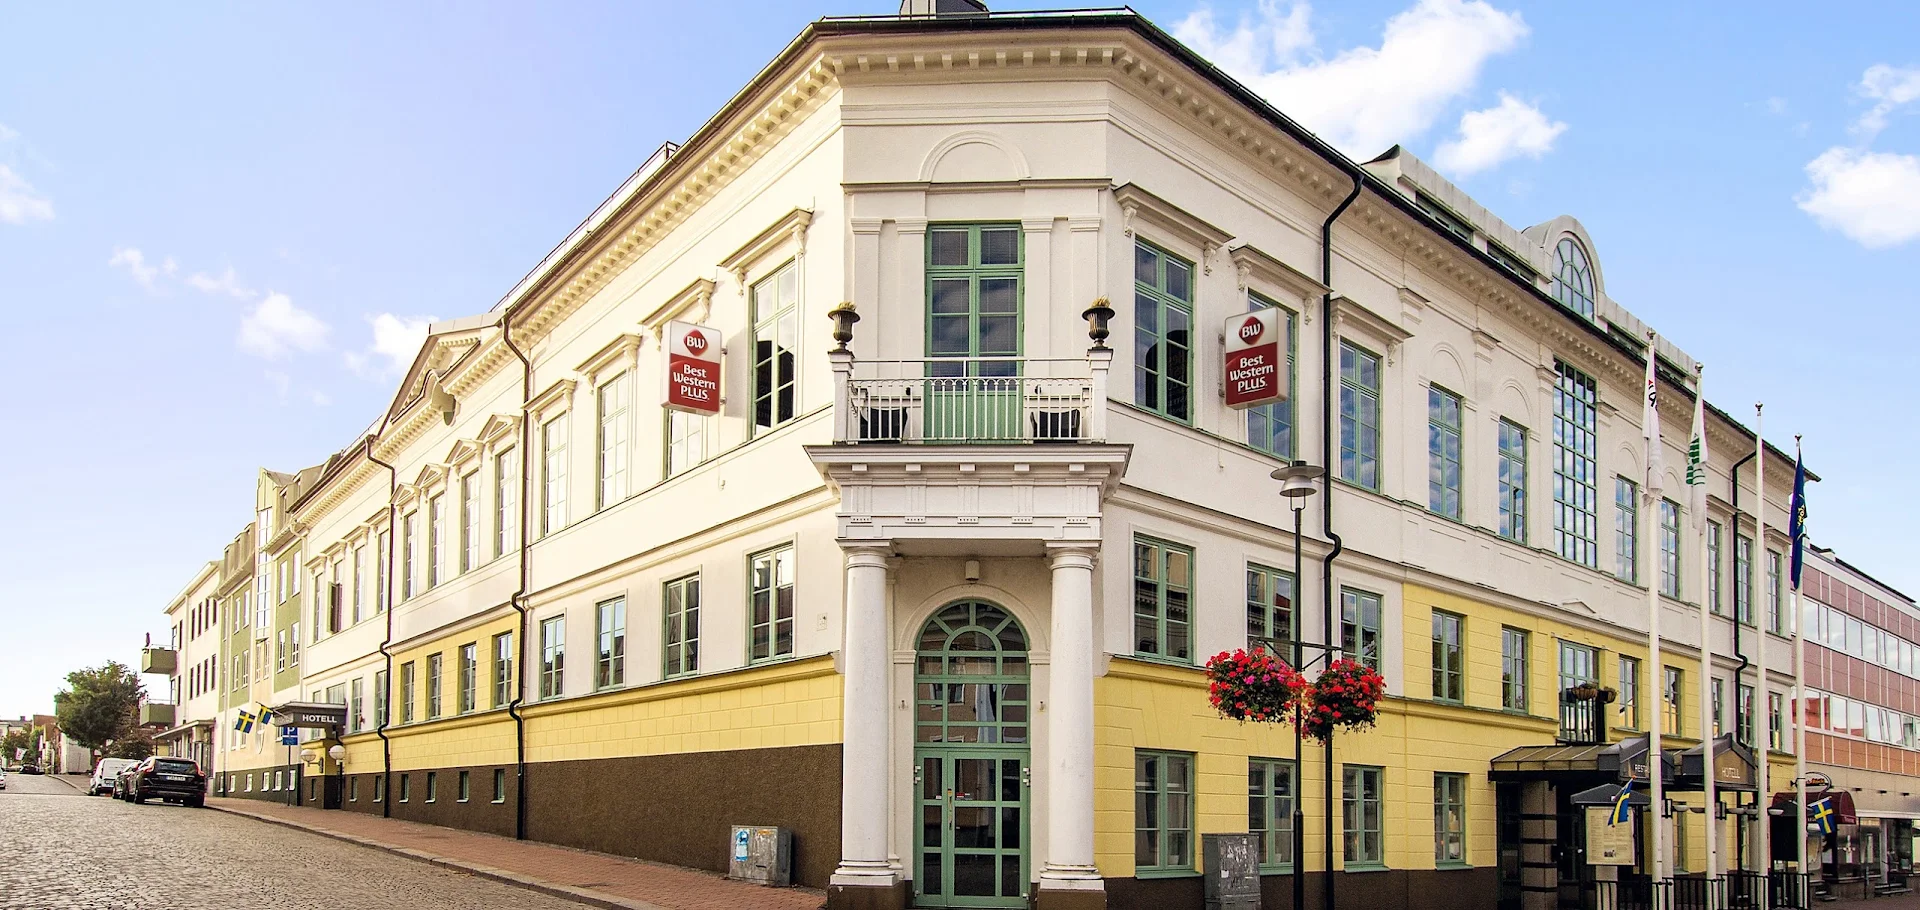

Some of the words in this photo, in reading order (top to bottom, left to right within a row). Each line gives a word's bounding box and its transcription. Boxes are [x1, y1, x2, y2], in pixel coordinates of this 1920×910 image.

[1241, 323, 1261, 338] BW
[686, 335, 705, 349] BW
[1240, 354, 1264, 368] Best
[683, 363, 707, 377] Best
[1229, 364, 1274, 381] Western
[673, 372, 716, 390] Western
[302, 714, 338, 723] HOTELL
[287, 726, 295, 735] P
[1721, 767, 1741, 779] HOTELL
